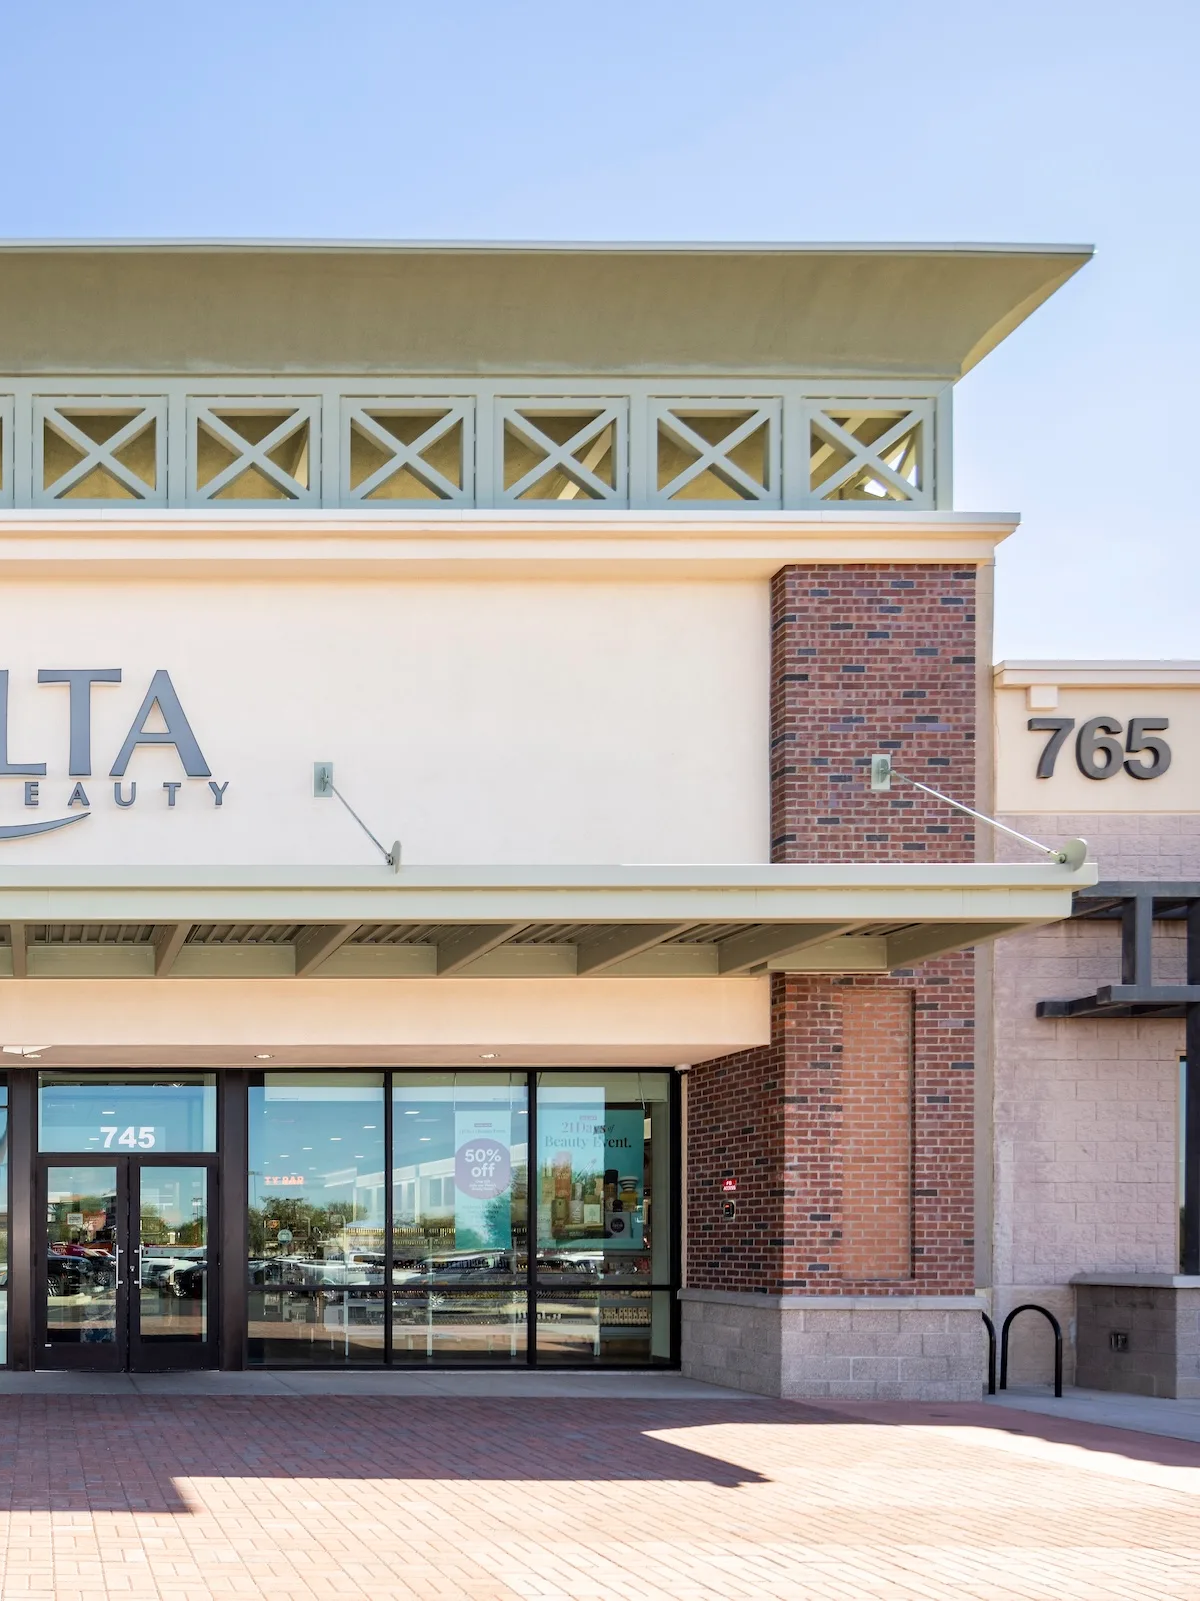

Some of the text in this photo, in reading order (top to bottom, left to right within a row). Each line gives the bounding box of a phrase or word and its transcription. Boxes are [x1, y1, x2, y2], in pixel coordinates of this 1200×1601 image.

[1027, 716, 1172, 780] 765
[561, 1122, 574, 1133] 21
[100, 1126, 156, 1149] 745
[544, 1136, 588, 1149] Beauty
[464, 1148, 502, 1163] 50%
[471, 1162, 496, 1177] off
